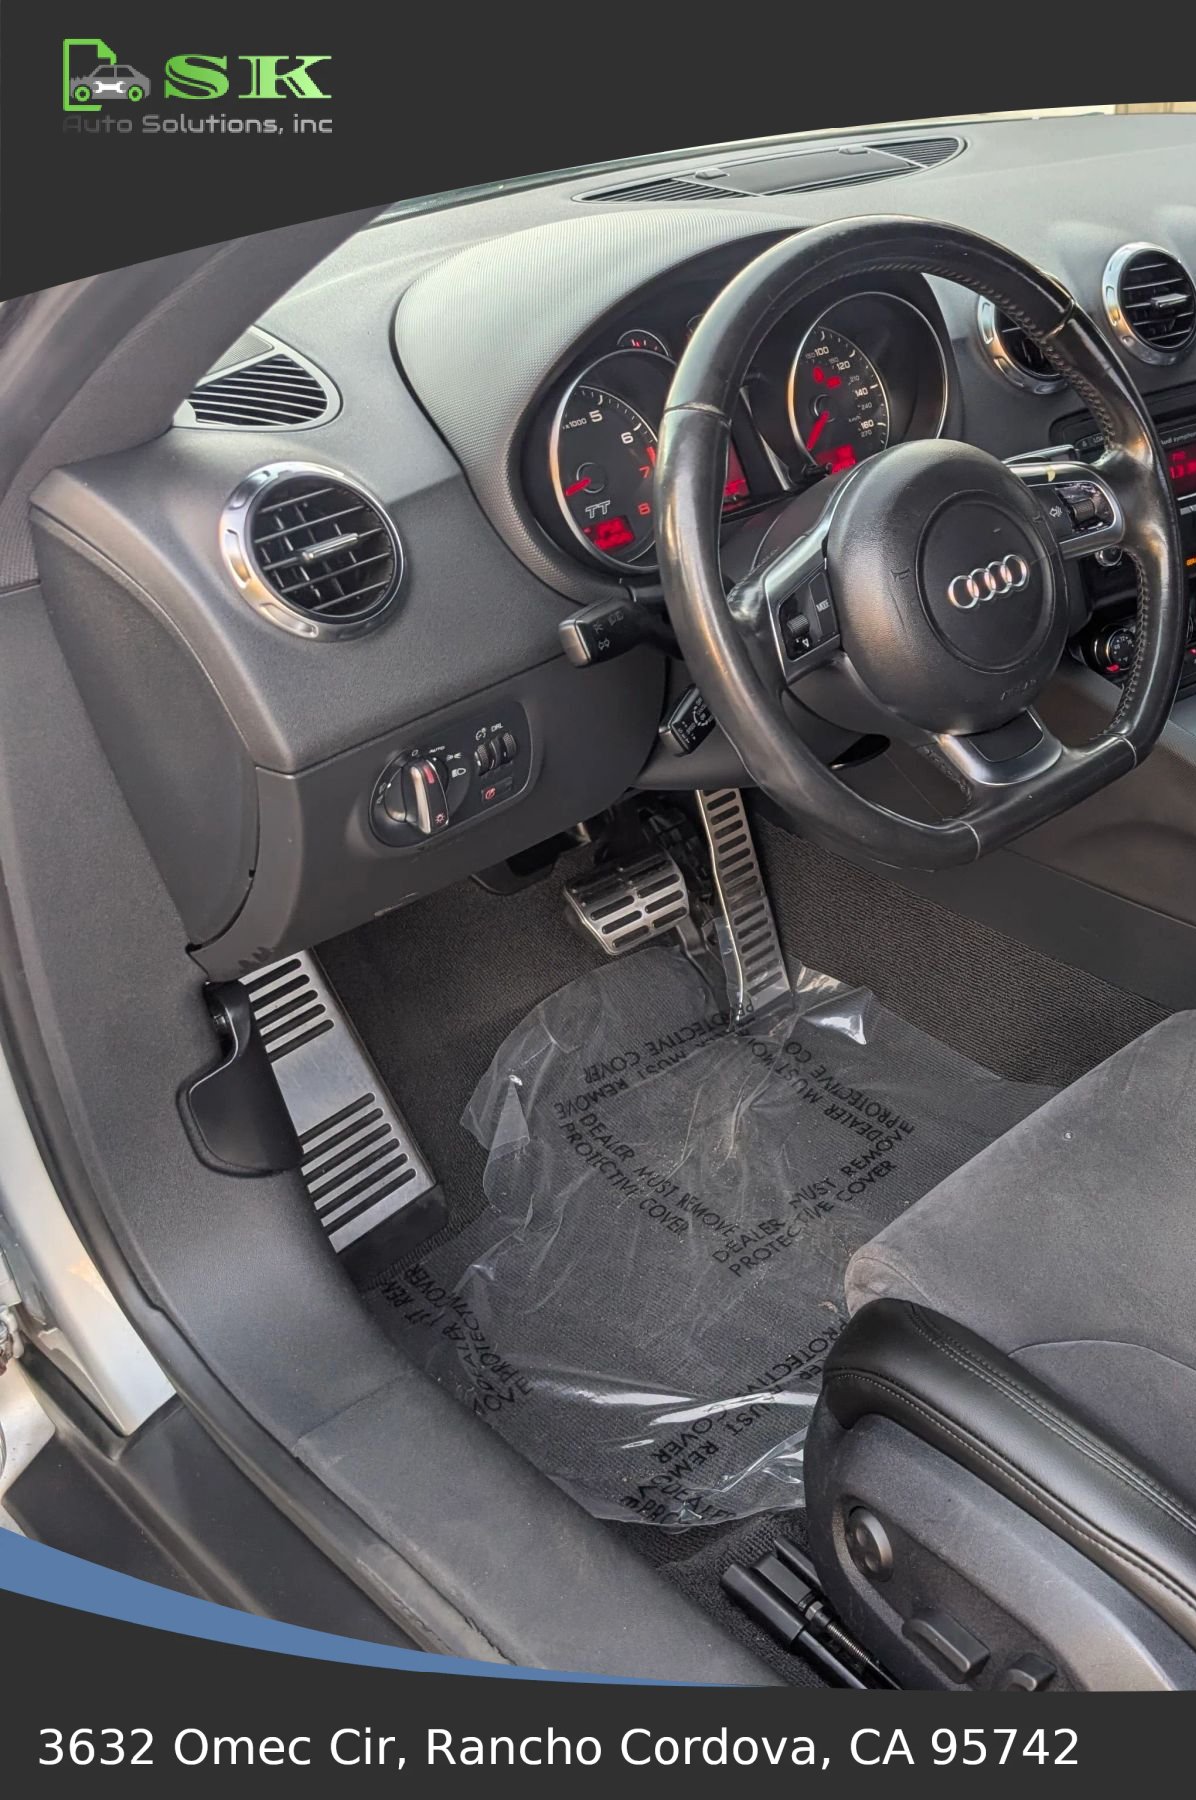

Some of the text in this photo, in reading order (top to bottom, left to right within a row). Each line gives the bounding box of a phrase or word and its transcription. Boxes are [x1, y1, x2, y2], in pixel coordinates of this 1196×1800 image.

[814, 346, 829, 357] 100
[836, 360, 851, 371] 120
[854, 389, 868, 399] 140
[589, 409, 604, 423] 5
[860, 418, 874, 430] 160
[620, 431, 634, 445] 6
[639, 464, 651, 479] 7
[585, 499, 612, 520] TT
[638, 502, 652, 516] 8
[583, 1051, 640, 1084] COVER
[553, 1077, 629, 1120] REMOVE
[775, 1063, 883, 1142] DEALER MUST
[810, 1064, 901, 1129] PROTECTIVE
[559, 1121, 690, 1236] PROTECTIVE COVER
[579, 1112, 740, 1238] DEALER MUST REMOVE
[712, 1120, 915, 1264] DEALER MUST REMOVE
[728, 1159, 897, 1278] PROTECTIVE COVER
